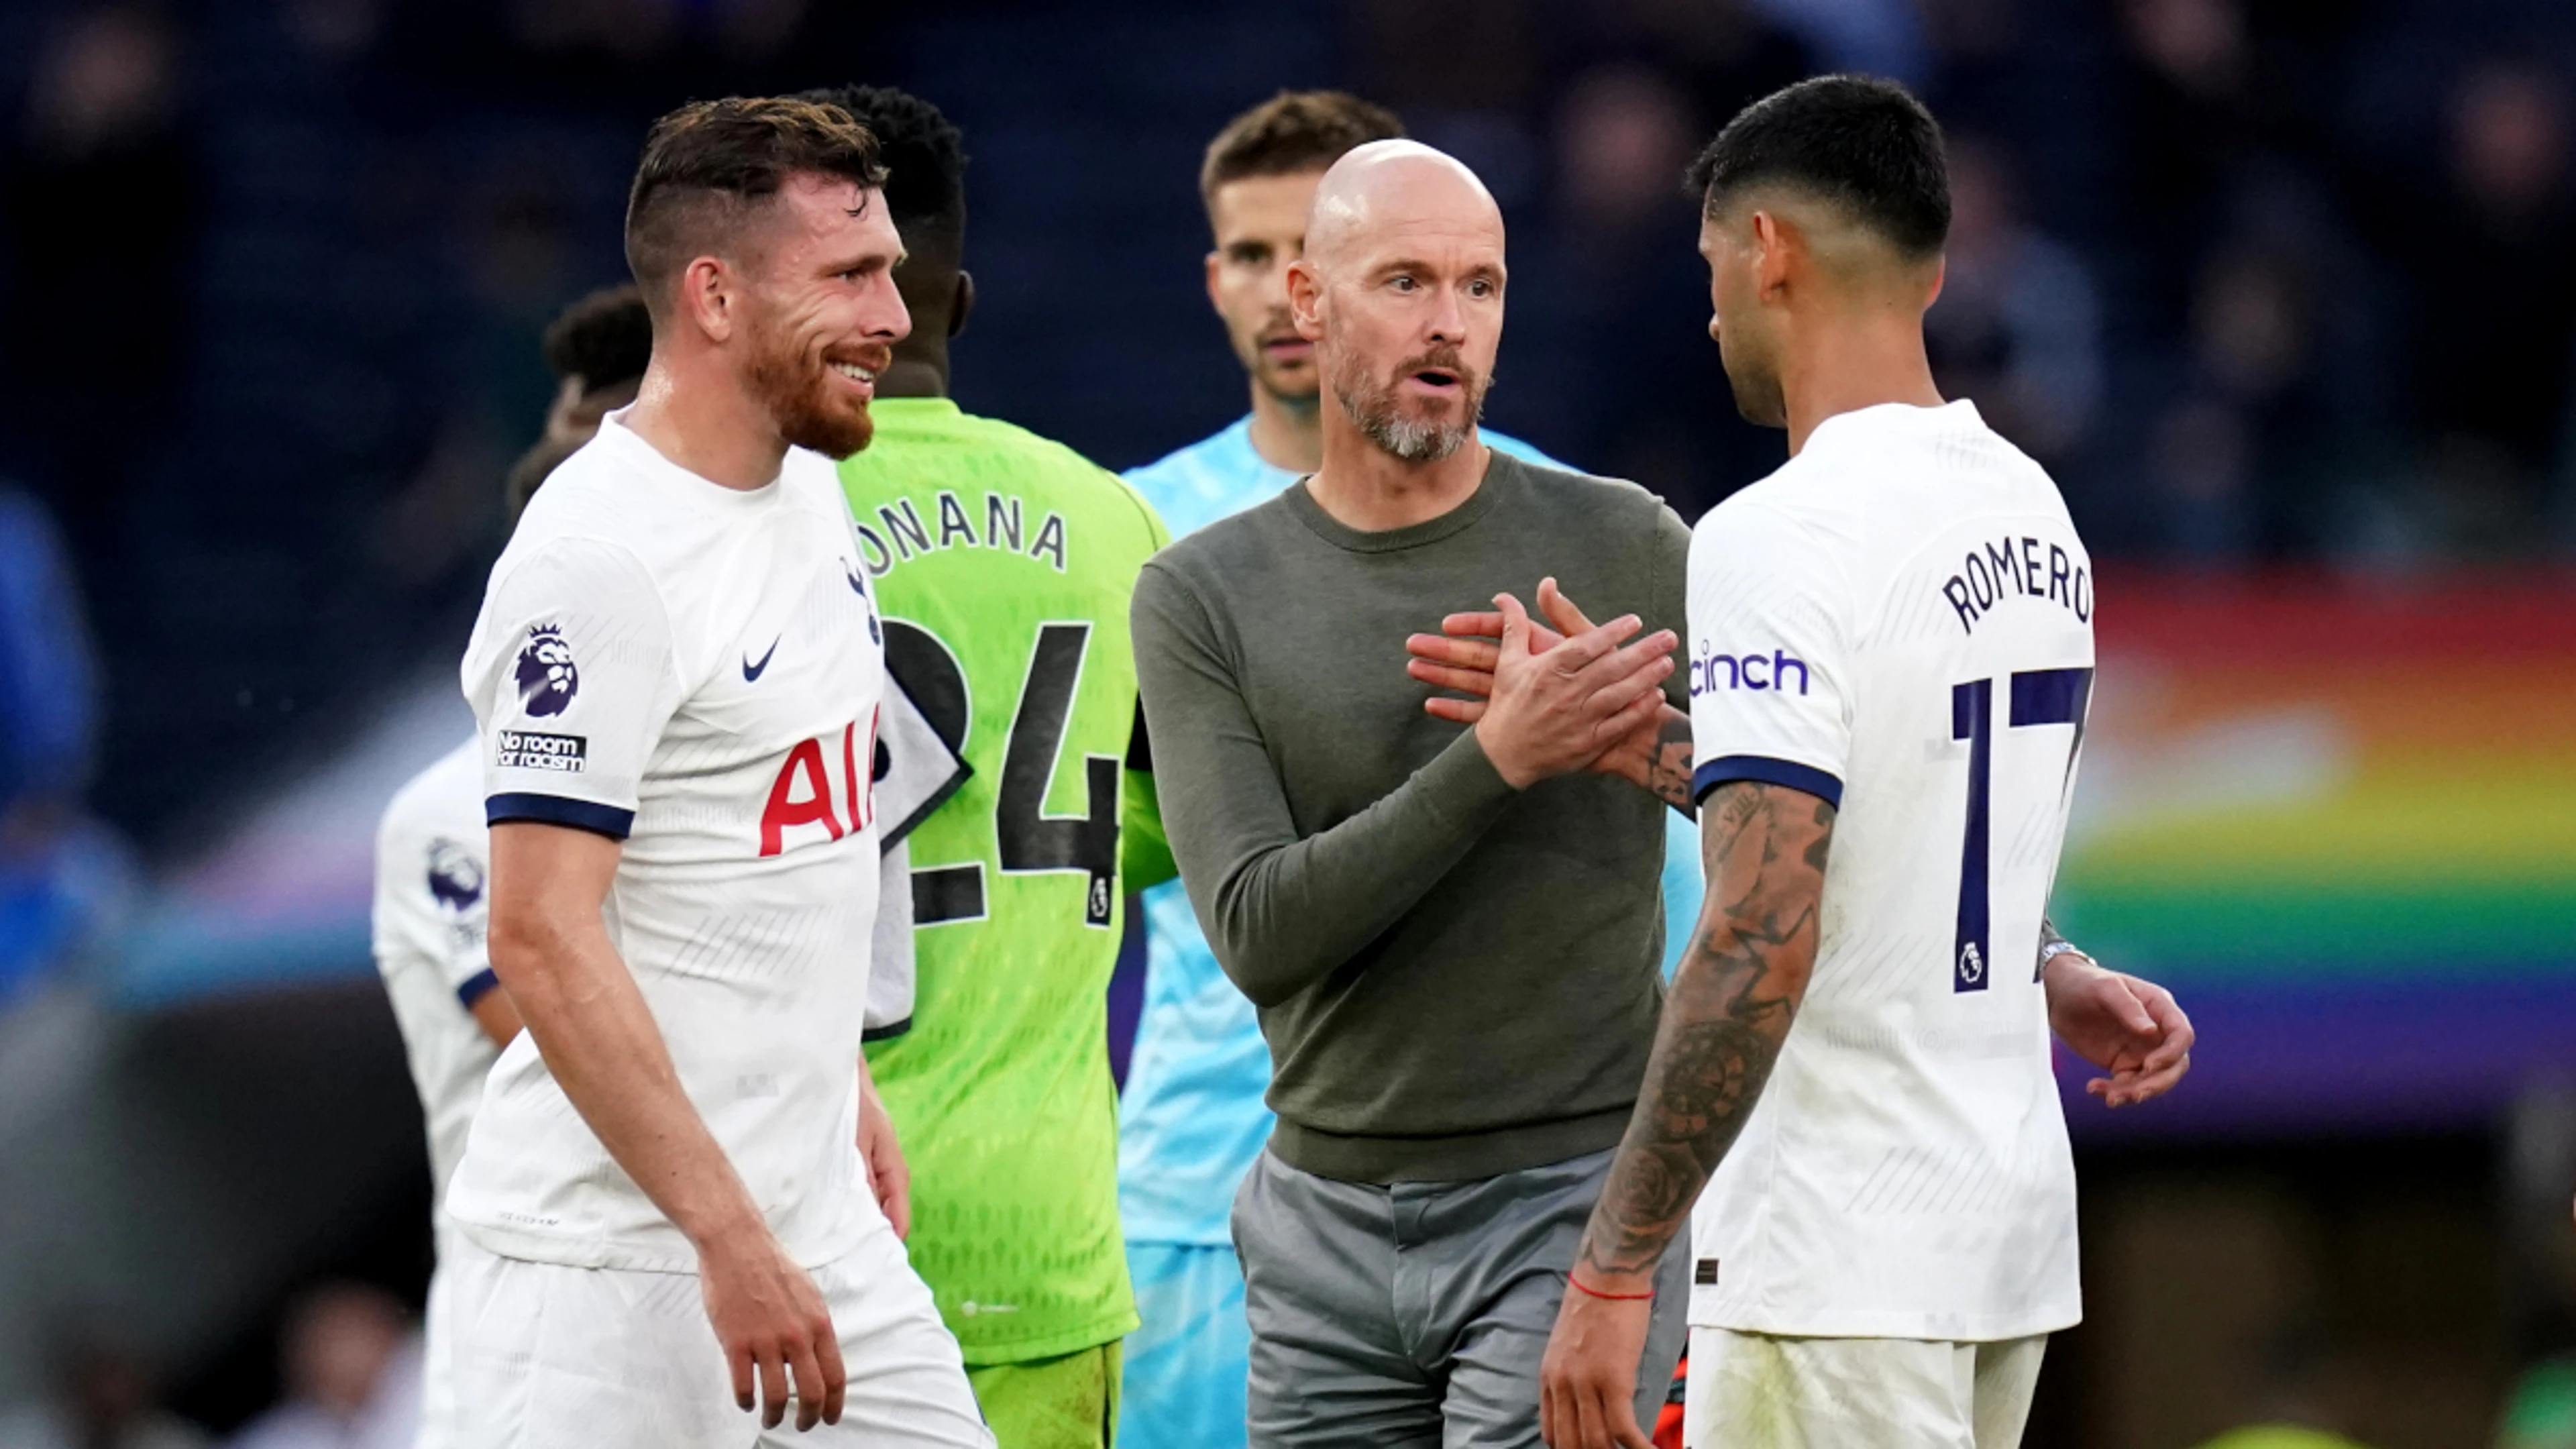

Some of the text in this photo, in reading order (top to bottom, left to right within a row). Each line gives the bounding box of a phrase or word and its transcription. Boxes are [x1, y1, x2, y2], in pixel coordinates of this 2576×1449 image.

[1942, 536, 2090, 637] ROMERO
[1690, 639, 1808, 697] cinch
[499, 731, 577, 754] No room
[519, 752, 584, 771] racism
[759, 700, 880, 857] AI
[1952, 667, 2096, 994] 17
